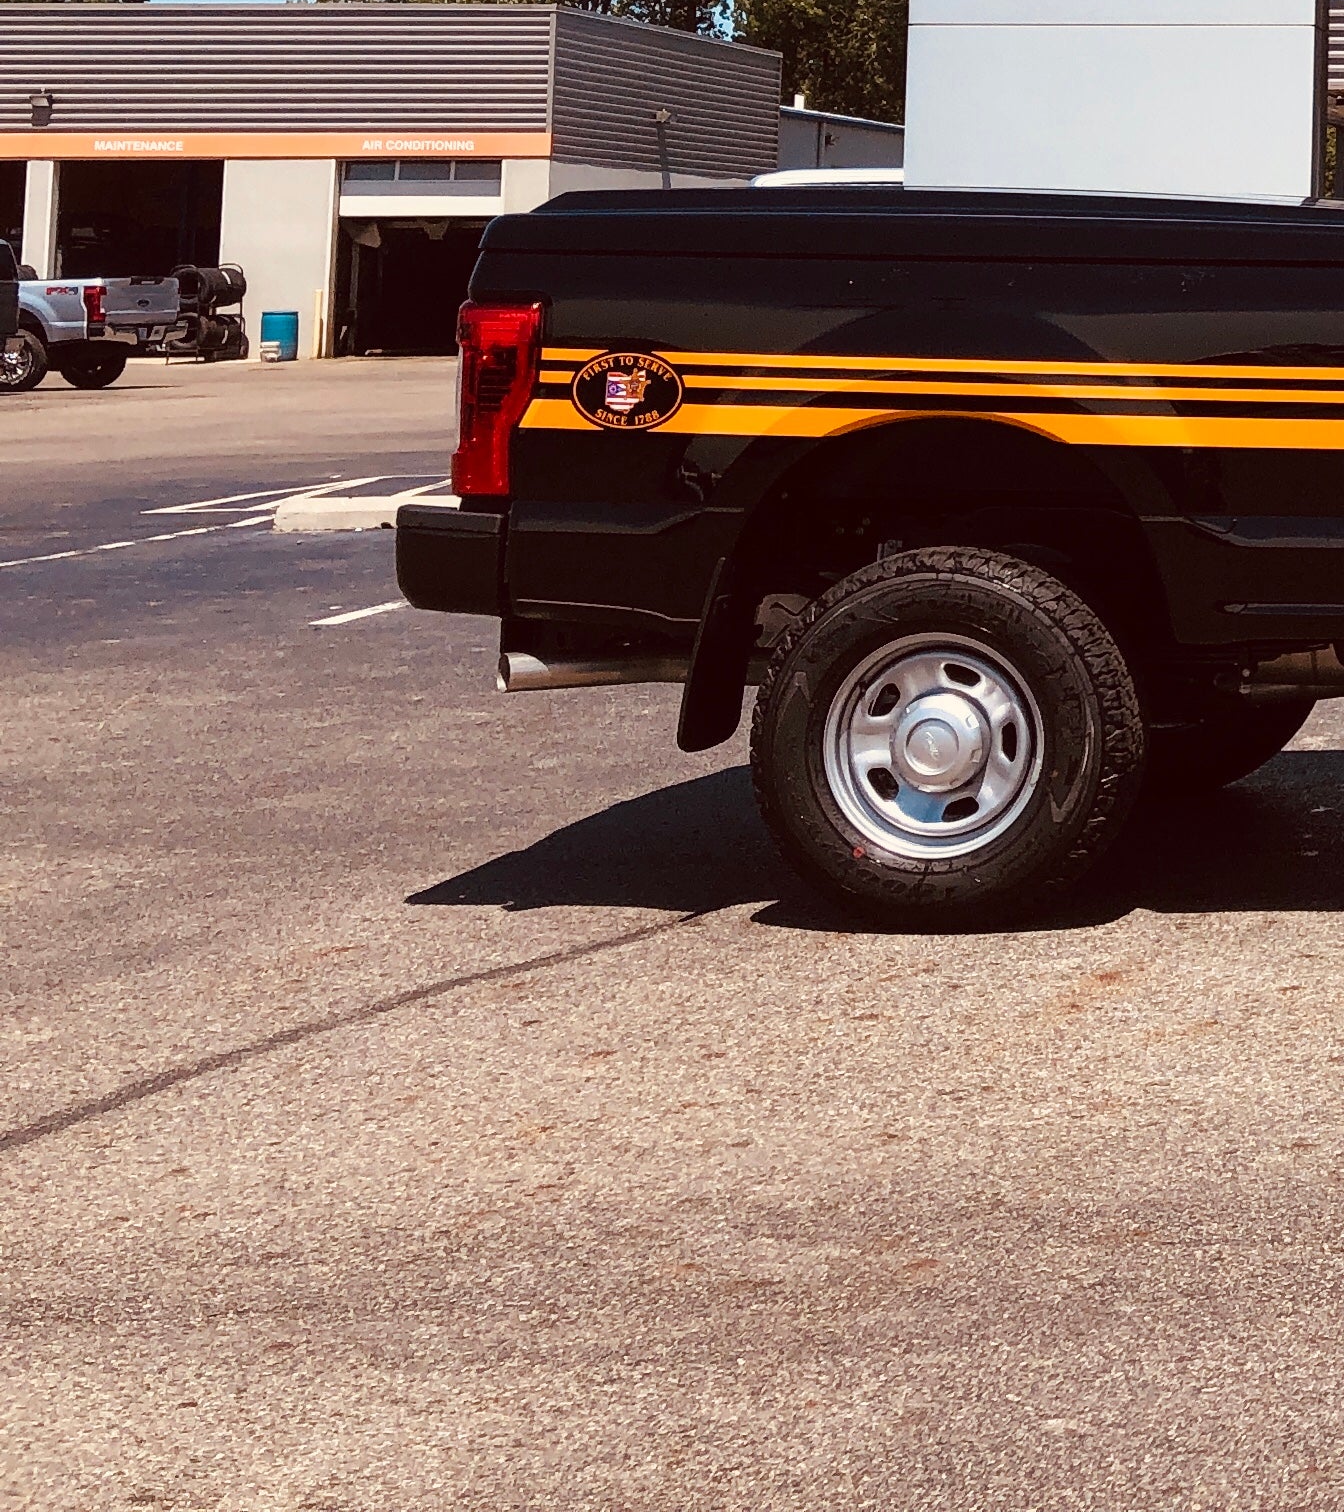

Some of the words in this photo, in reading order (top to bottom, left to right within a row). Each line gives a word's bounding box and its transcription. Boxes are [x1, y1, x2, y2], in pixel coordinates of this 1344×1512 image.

[94, 140, 184, 152] MAINTENANCE
[362, 140, 383, 151] AIR
[385, 140, 475, 152] CONDITIONING
[583, 357, 615, 381] FIRST
[619, 356, 634, 366] TO
[637, 358, 673, 382] SERVE
[594, 408, 628, 426] SINCE
[634, 409, 660, 426] 1788
